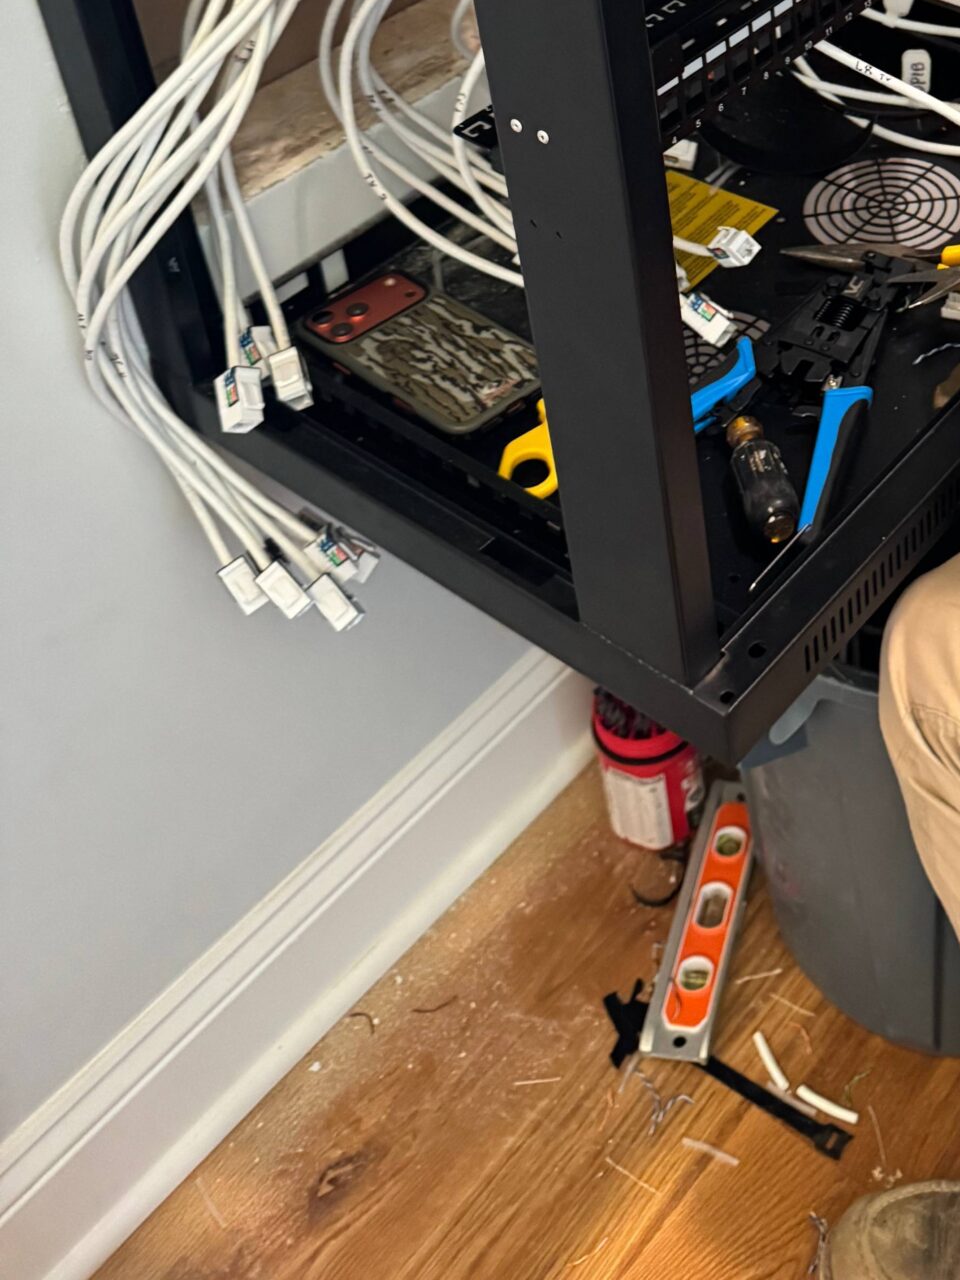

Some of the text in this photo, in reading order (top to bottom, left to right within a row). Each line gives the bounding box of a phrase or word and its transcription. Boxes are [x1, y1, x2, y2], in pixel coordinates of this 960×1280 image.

[672, 136, 678, 144] 4
[696, 119, 702, 128] 5
[718, 103, 724, 112] 6
[741, 87, 747, 95] 7
[763, 72, 769, 80] 8
[785, 56, 791, 65] 9
[825, 26, 833, 36] 11
[845, 12, 853, 21] 12
